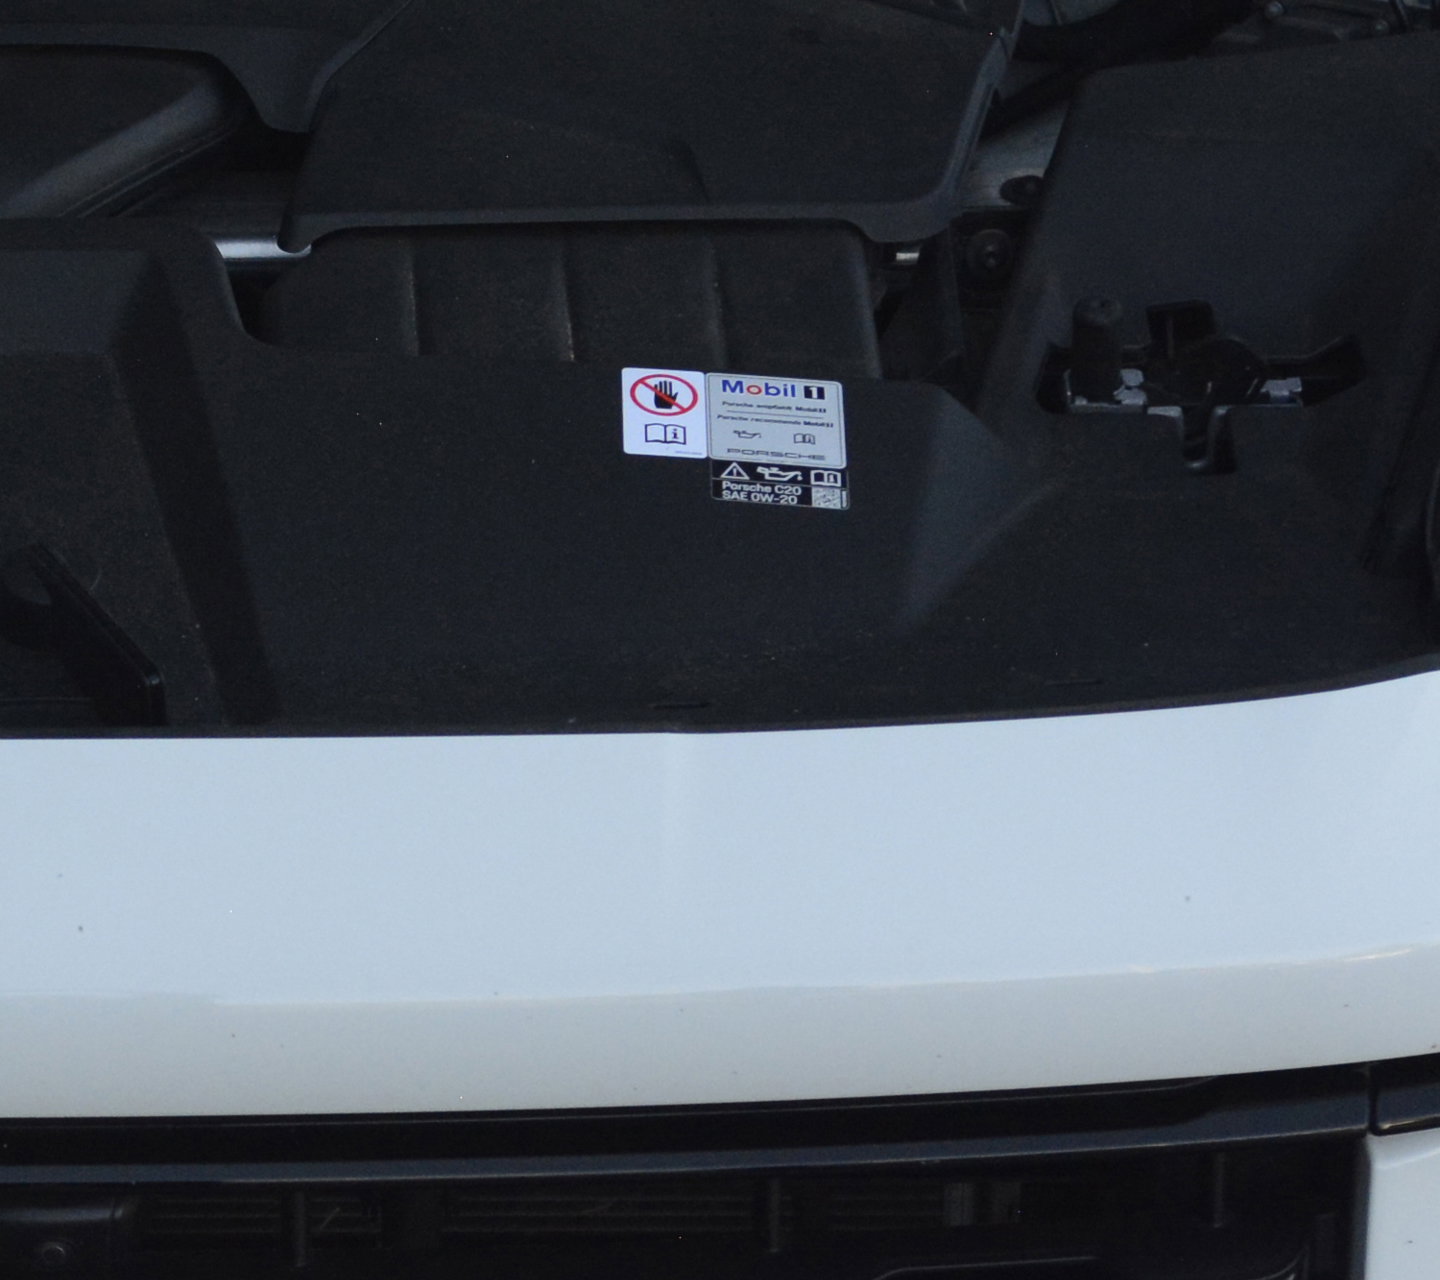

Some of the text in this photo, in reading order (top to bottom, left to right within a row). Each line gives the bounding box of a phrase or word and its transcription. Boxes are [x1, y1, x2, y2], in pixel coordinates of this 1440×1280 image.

[722, 379, 796, 397] Mobil
[727, 448, 826, 460] PORSCHE
[722, 481, 802, 495] Porsche C20
[722, 490, 798, 505] SAE 0W-20
